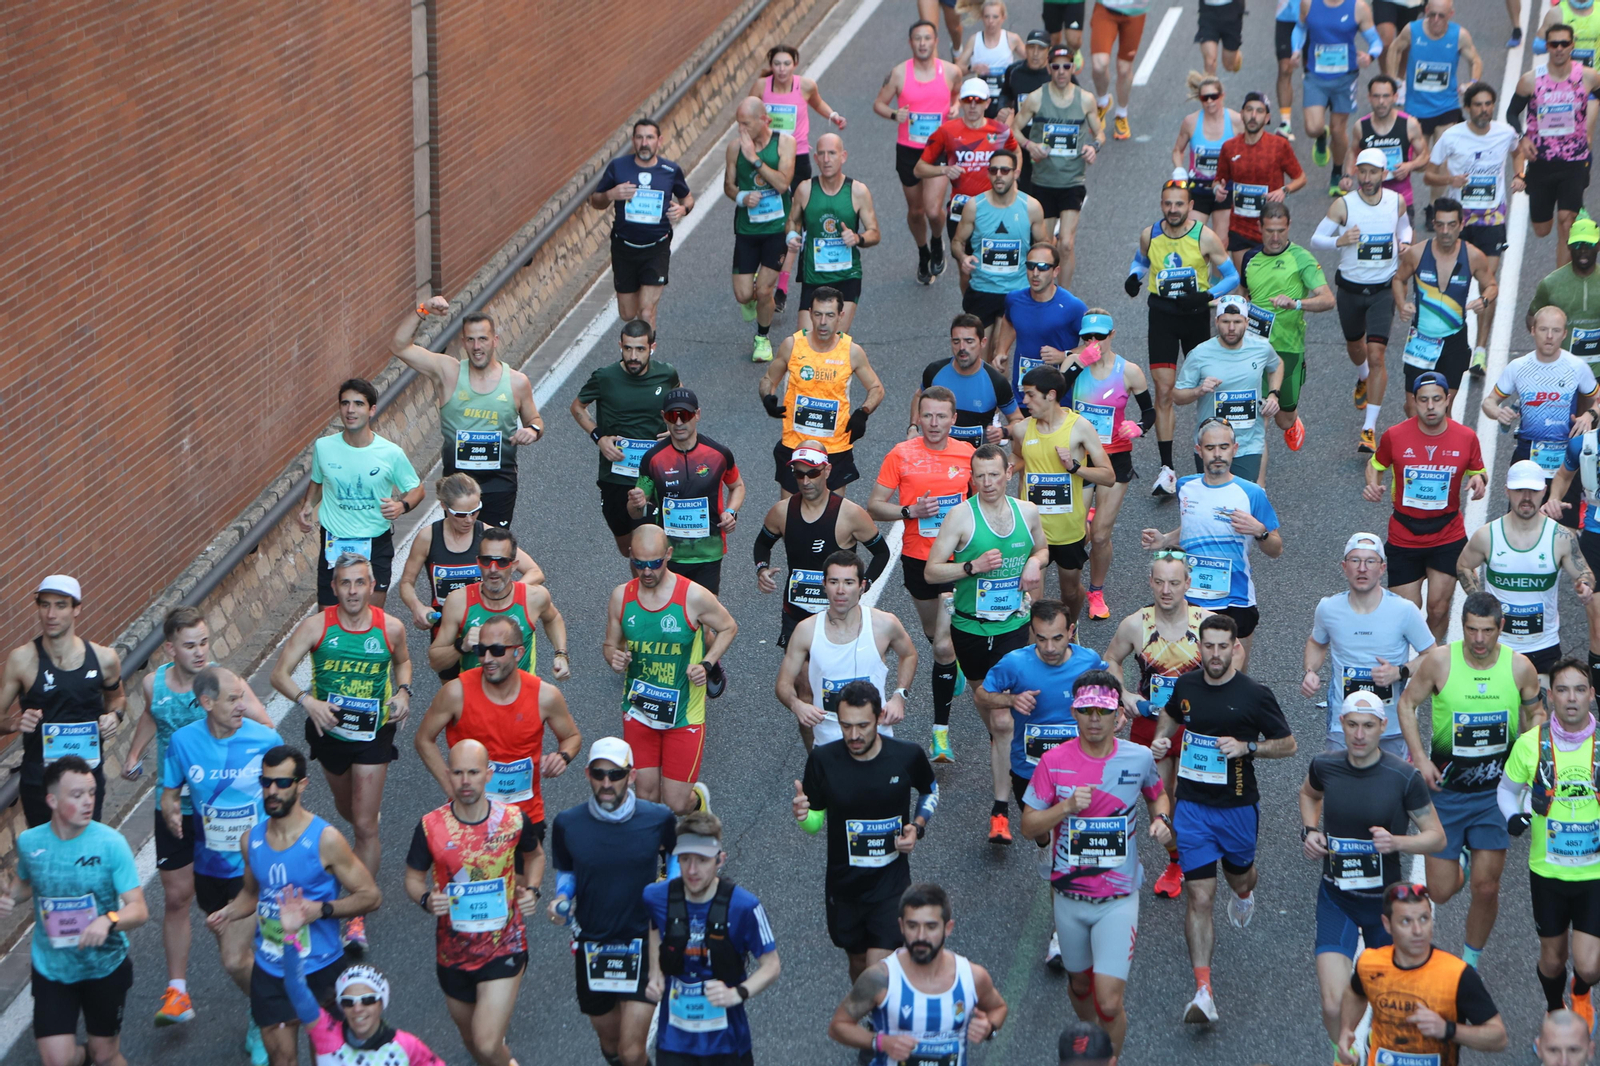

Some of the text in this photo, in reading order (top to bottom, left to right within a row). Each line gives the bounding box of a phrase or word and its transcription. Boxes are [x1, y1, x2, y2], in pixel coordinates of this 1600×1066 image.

[955, 150, 995, 162] YORK
[1170, 269, 1191, 277] ZURICH
[1251, 307, 1270, 320] ZURICH
[1230, 392, 1253, 400] ZURICH
[811, 400, 834, 409] ZURICH
[1086, 406, 1109, 415] ZURICH
[805, 420, 824, 429] CARLOS
[954, 428, 977, 436] ZURICH
[677, 501, 702, 509] ZURICH
[939, 497, 960, 506] URICH
[1199, 560, 1225, 568] ZURICH
[1010, 566, 1023, 576] CLU
[994, 580, 1019, 589] ZURICH
[1494, 576, 1548, 588] RAHENY
[1512, 606, 1539, 614] ZURICH
[1511, 619, 1528, 627] 2442
[652, 661, 676, 669] RUN
[649, 668, 675, 677] WITH
[657, 676, 675, 685] ME
[1358, 684, 1374, 692] 2441
[646, 687, 672, 699] ZURICH
[345, 699, 374, 708] ZURICH
[642, 701, 659, 712] 2722
[1473, 714, 1502, 723] ZURICH
[62, 725, 92, 734] ZURICH
[1043, 728, 1072, 736] ZURICH
[1472, 729, 1490, 737] 2582
[1193, 737, 1217, 747] ZURIC
[1193, 753, 1208, 762] 4529
[498, 763, 527, 772] ZURICH
[1194, 763, 1207, 771] AMIT
[210, 768, 263, 781] ZURICH
[498, 778, 515, 786] 4162
[220, 808, 250, 818] ZURICH
[867, 822, 896, 831] ZURICH
[1089, 820, 1121, 829] ZURICH
[1565, 823, 1595, 832] ZURICH
[867, 839, 885, 847] 2687
[1089, 837, 1108, 846] 3140
[1565, 839, 1583, 847] 4857
[1342, 843, 1373, 851] ZURICH
[1552, 847, 1574, 856] SERGIO
[1105, 848, 1116, 856] BAI
[1342, 858, 1362, 867] 2624
[1341, 868, 1364, 877] RUBÉN
[467, 883, 499, 895] ZURICH
[56, 899, 89, 910] ZURICH
[469, 901, 488, 910] 4733
[604, 971, 627, 979] WILLIAM
[921, 1043, 954, 1053] ZURICH
[1396, 1056, 1432, 1066] ZURICH
